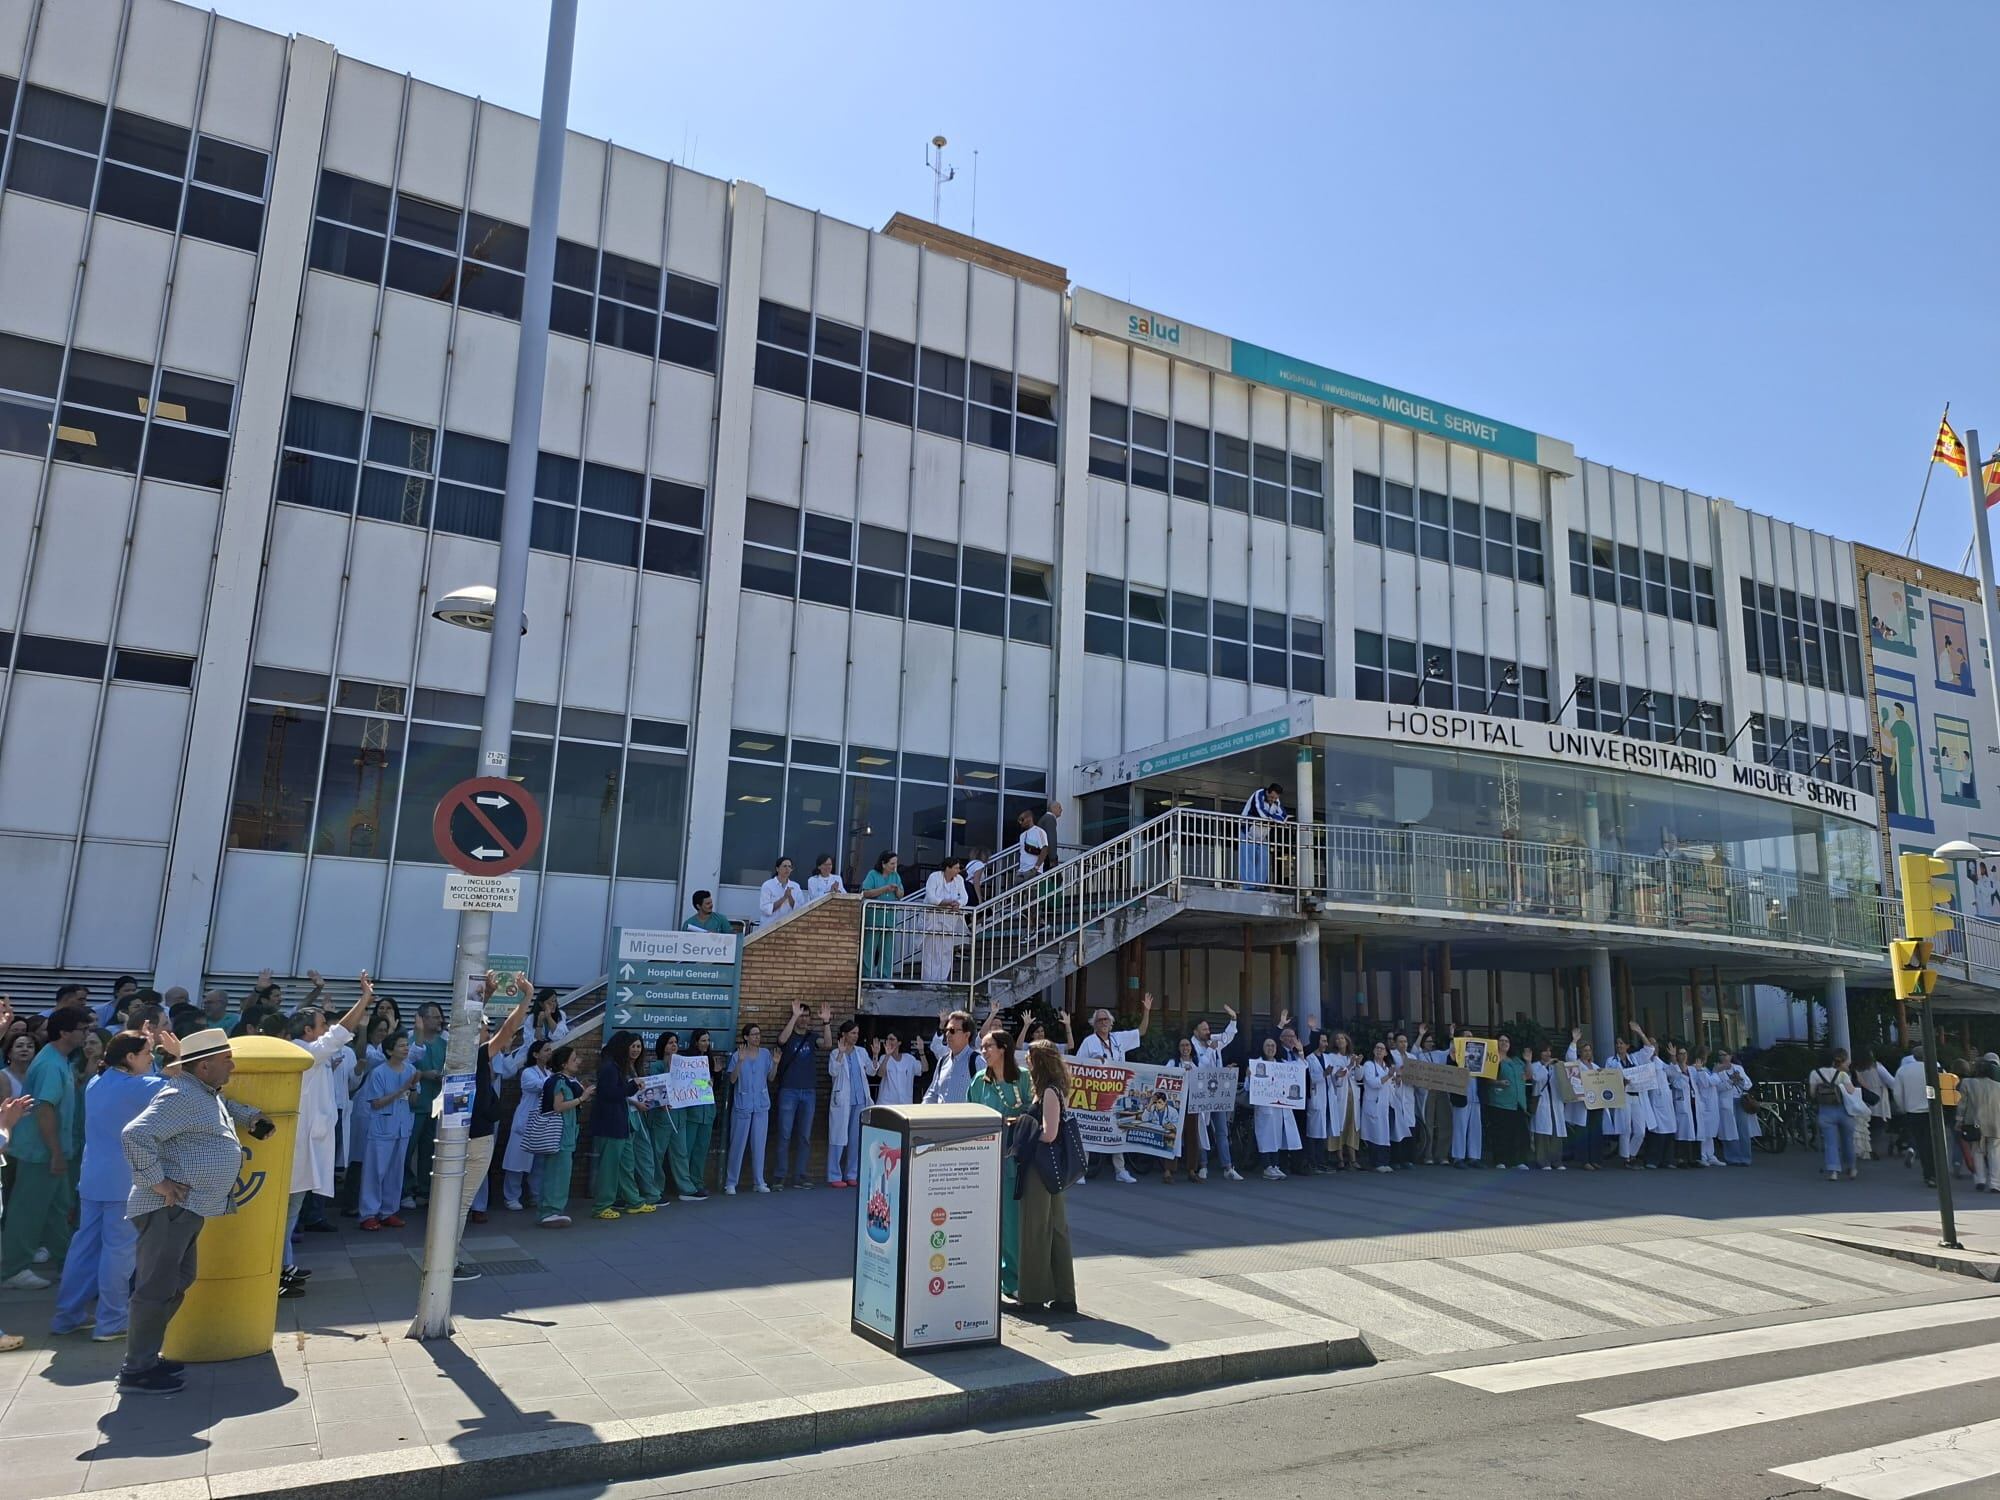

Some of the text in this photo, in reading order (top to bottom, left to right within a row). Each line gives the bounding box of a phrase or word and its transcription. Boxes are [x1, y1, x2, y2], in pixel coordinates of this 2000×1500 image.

[1128, 315, 1180, 344] salud
[1280, 369, 1499, 443] HOSPITAL UNIVERSITARIO MIGUEL SERVET
[1210, 740, 1232, 753] GRACIAS
[1232, 736, 1244, 747] POR
[1245, 733, 1254, 743] NO
[1255, 727, 1275, 740] FUMAR
[1387, 710, 1857, 812] HOSPITAL UNIVERSITARIO MIGUEL SERVET
[450, 886, 510, 894] MOTOCICLETAS
[452, 893, 514, 901] CICLOMOTORES
[630, 940, 728, 957] Miguel Servet
[647, 968, 719, 979] Hospital General
[645, 990, 729, 1001] Consultas Externas
[643, 1013, 688, 1024] Urgencias
[1110, 1069, 1126, 1080] UN
[1086, 1078, 1123, 1092] PROPIO
[1158, 1078, 1181, 1090] A1+
[1077, 1112, 1111, 1122] FORMACIÓN
[1128, 1129, 1155, 1139] AGENDAS
[963, 1320, 989, 1329] Zaragoza
